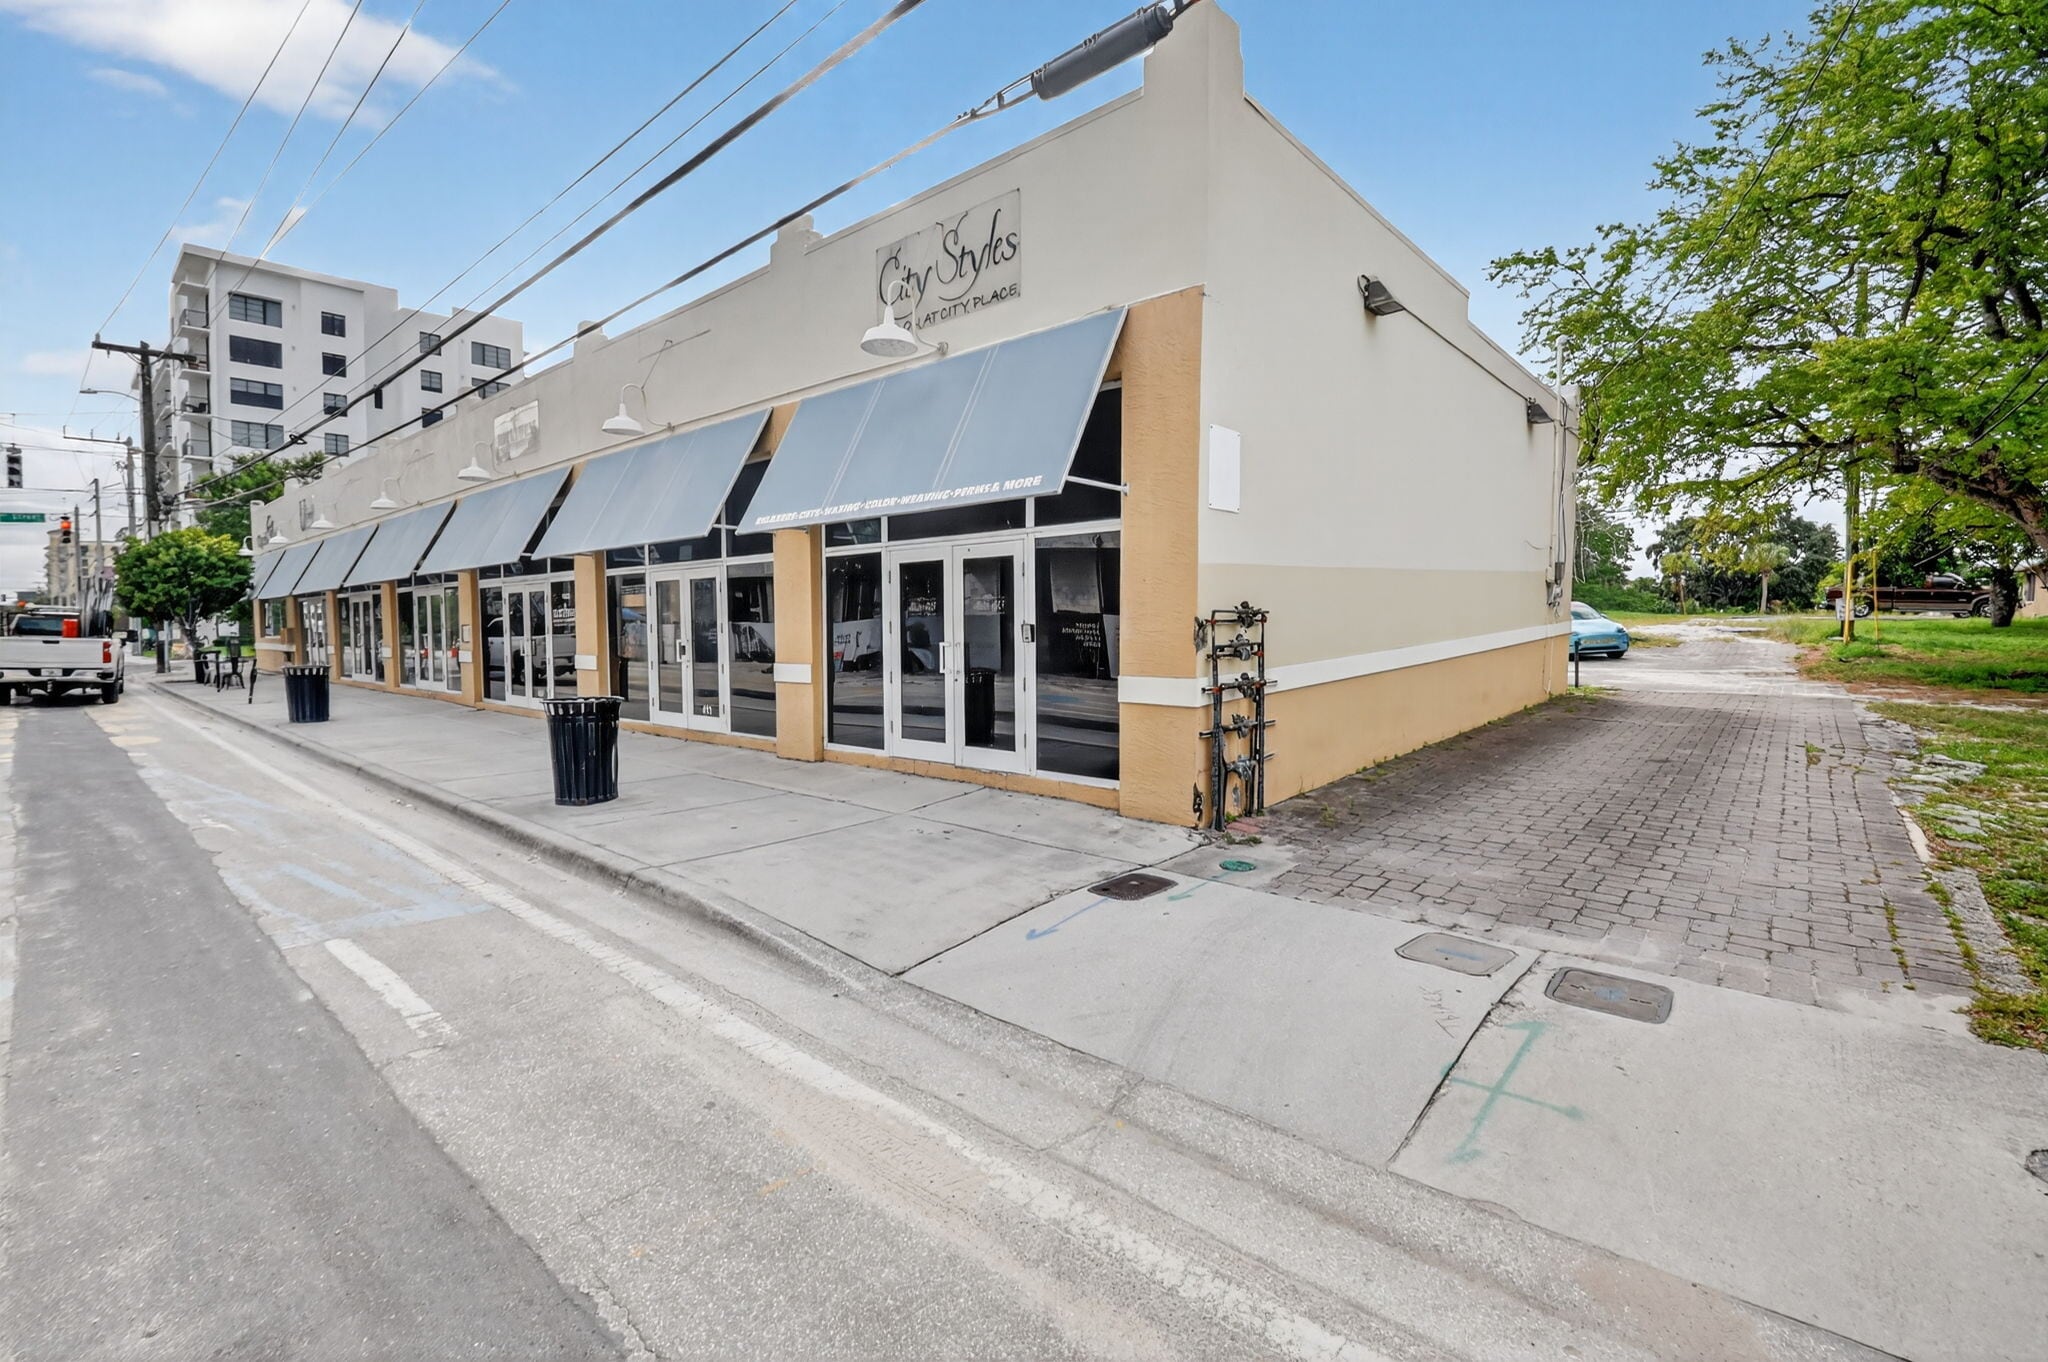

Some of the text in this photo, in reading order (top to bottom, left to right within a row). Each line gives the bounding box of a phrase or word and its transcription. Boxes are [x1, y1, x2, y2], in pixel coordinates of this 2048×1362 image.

[880, 209, 1018, 320] City Styles
[941, 299, 970, 319] CITY
[974, 283, 1018, 309] PLACE
[1002, 475, 1042, 491] MORE
